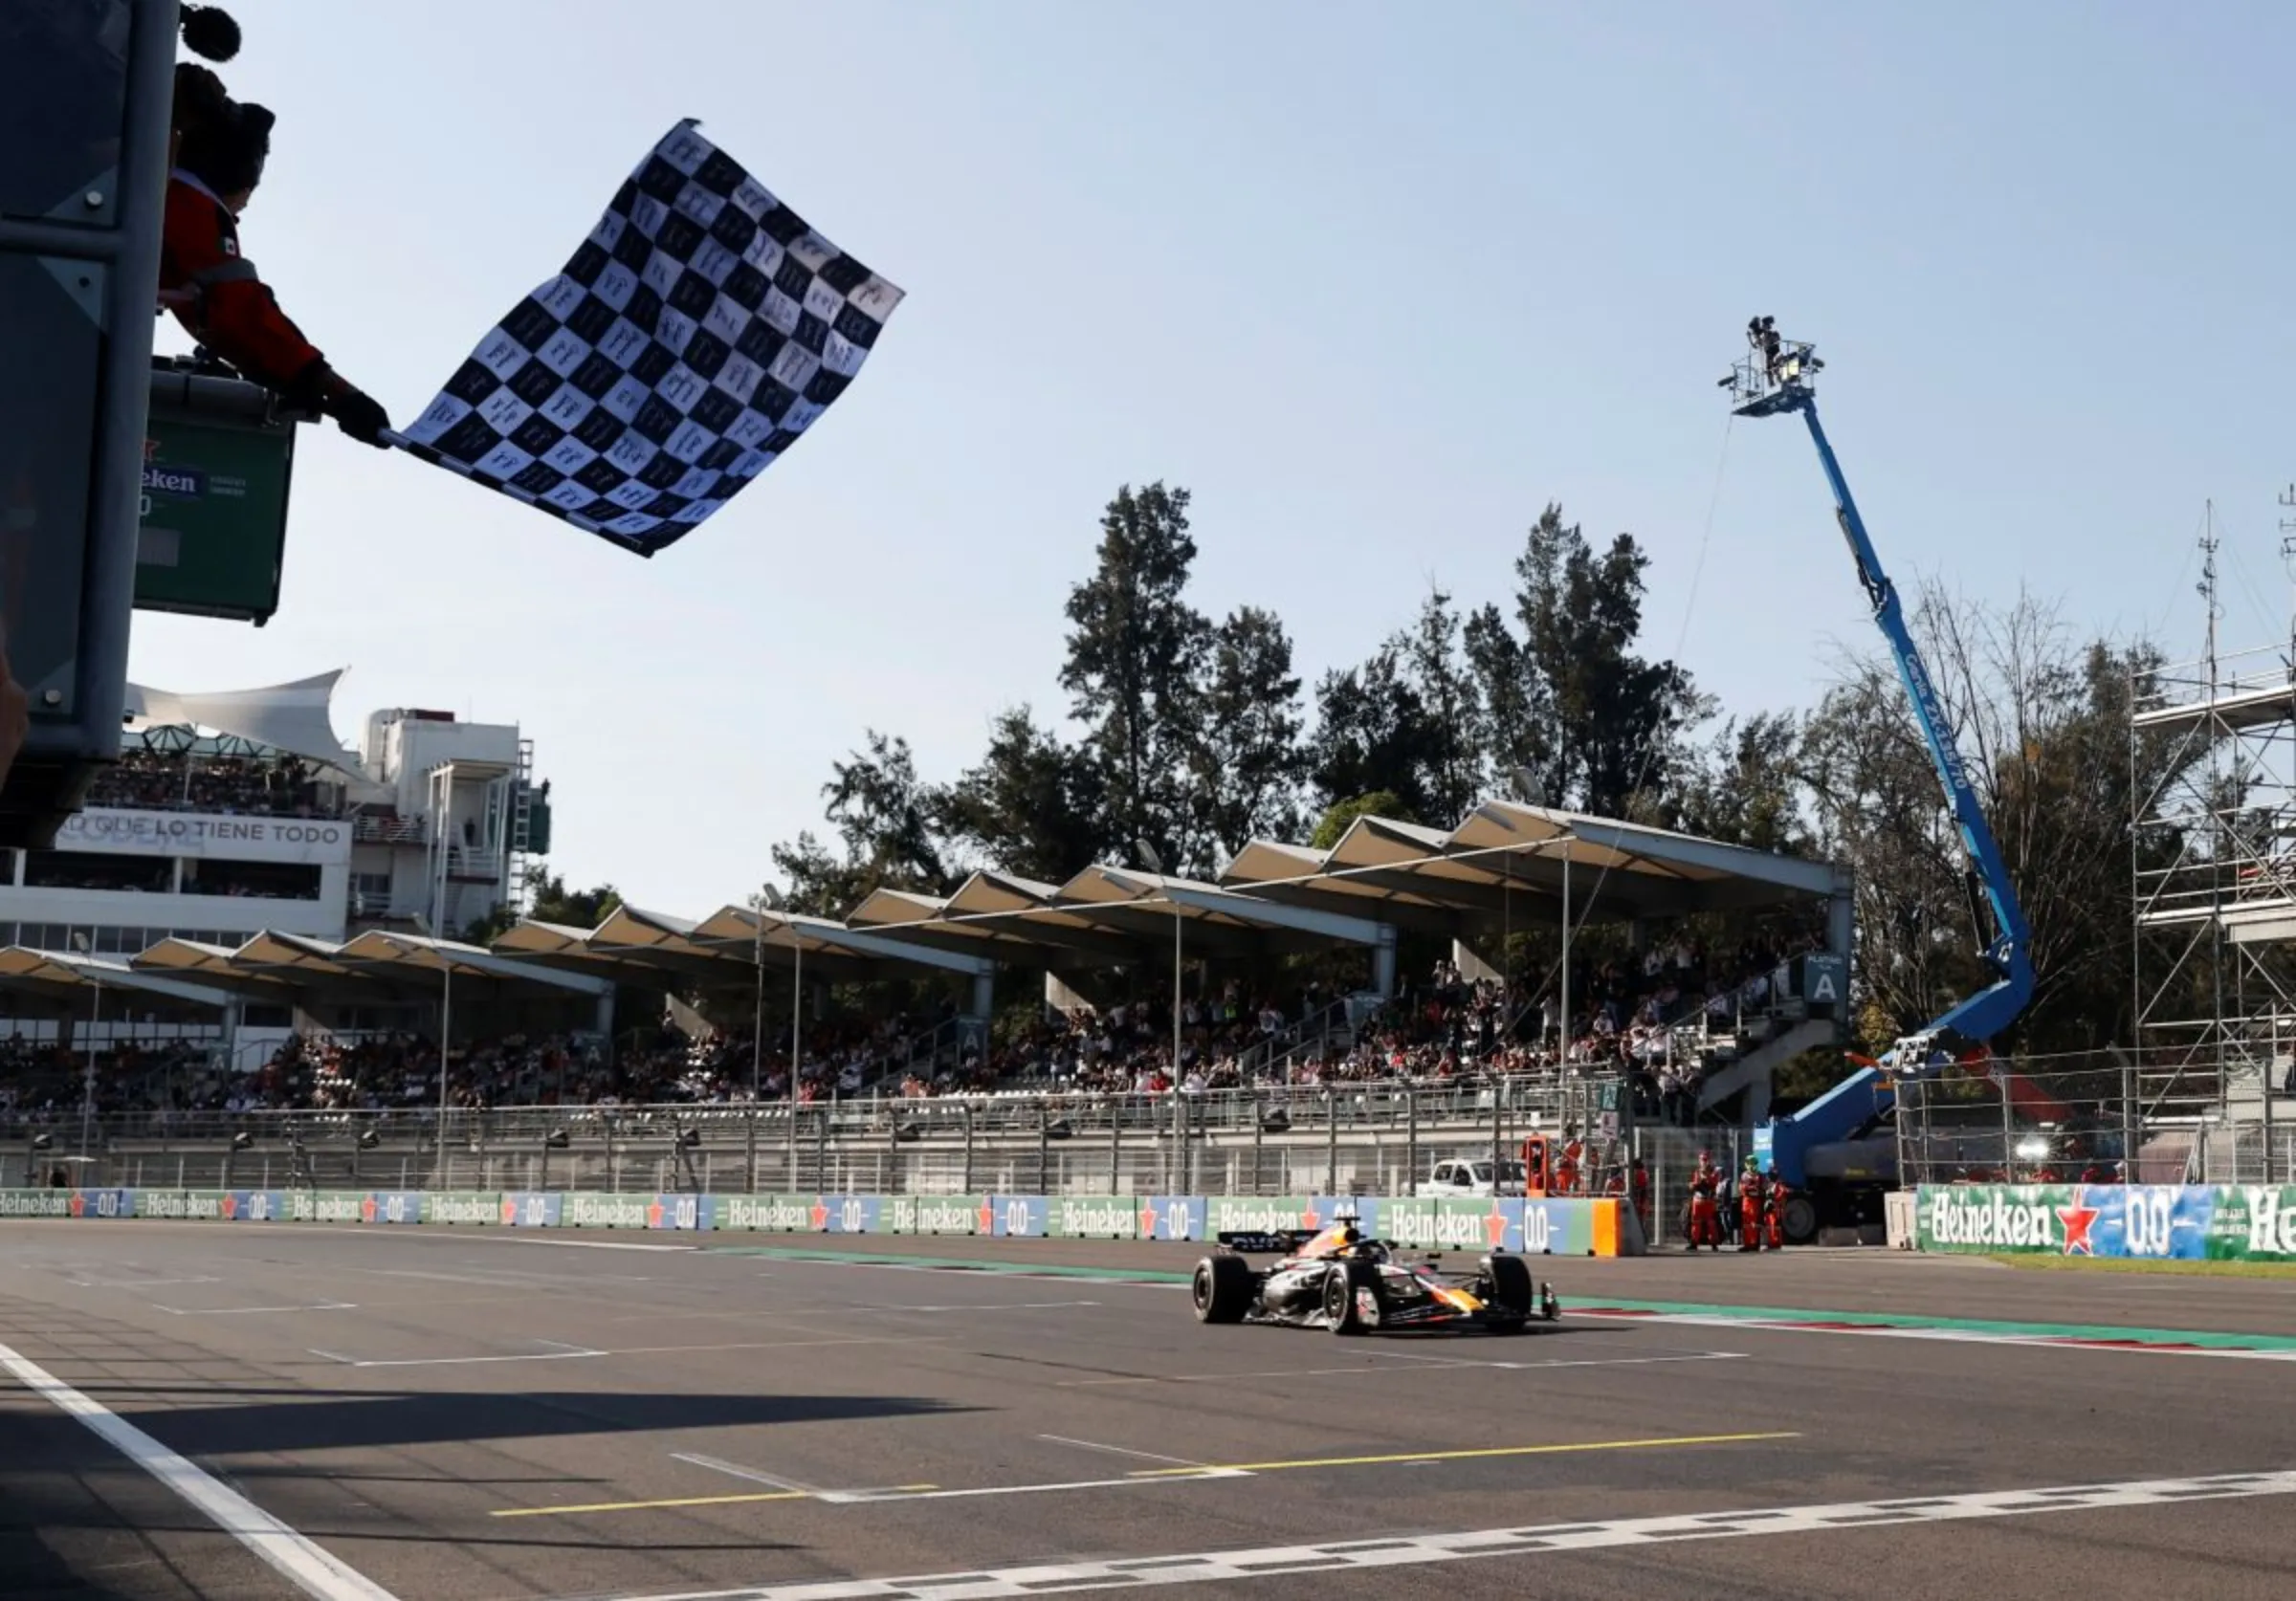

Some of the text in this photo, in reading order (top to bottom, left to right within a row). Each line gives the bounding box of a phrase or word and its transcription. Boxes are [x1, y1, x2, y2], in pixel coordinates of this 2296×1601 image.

[156, 819, 187, 837] LO
[193, 820, 264, 841] TIENE
[271, 824, 340, 844] TODO
[1814, 974, 1836, 999] A
[146, 1193, 217, 1216] Heineken
[294, 1194, 358, 1219] Heineken
[431, 1195, 497, 1221] Heineken
[573, 1197, 644, 1224] Heineken
[729, 1198, 806, 1227] Heineken
[894, 1200, 973, 1232] Heineken
[1062, 1201, 1136, 1234] Heineken
[1221, 1202, 1298, 1235] Heineken
[1932, 1192, 2053, 1245] Heineken
[1391, 1205, 1482, 1243] Heineken
